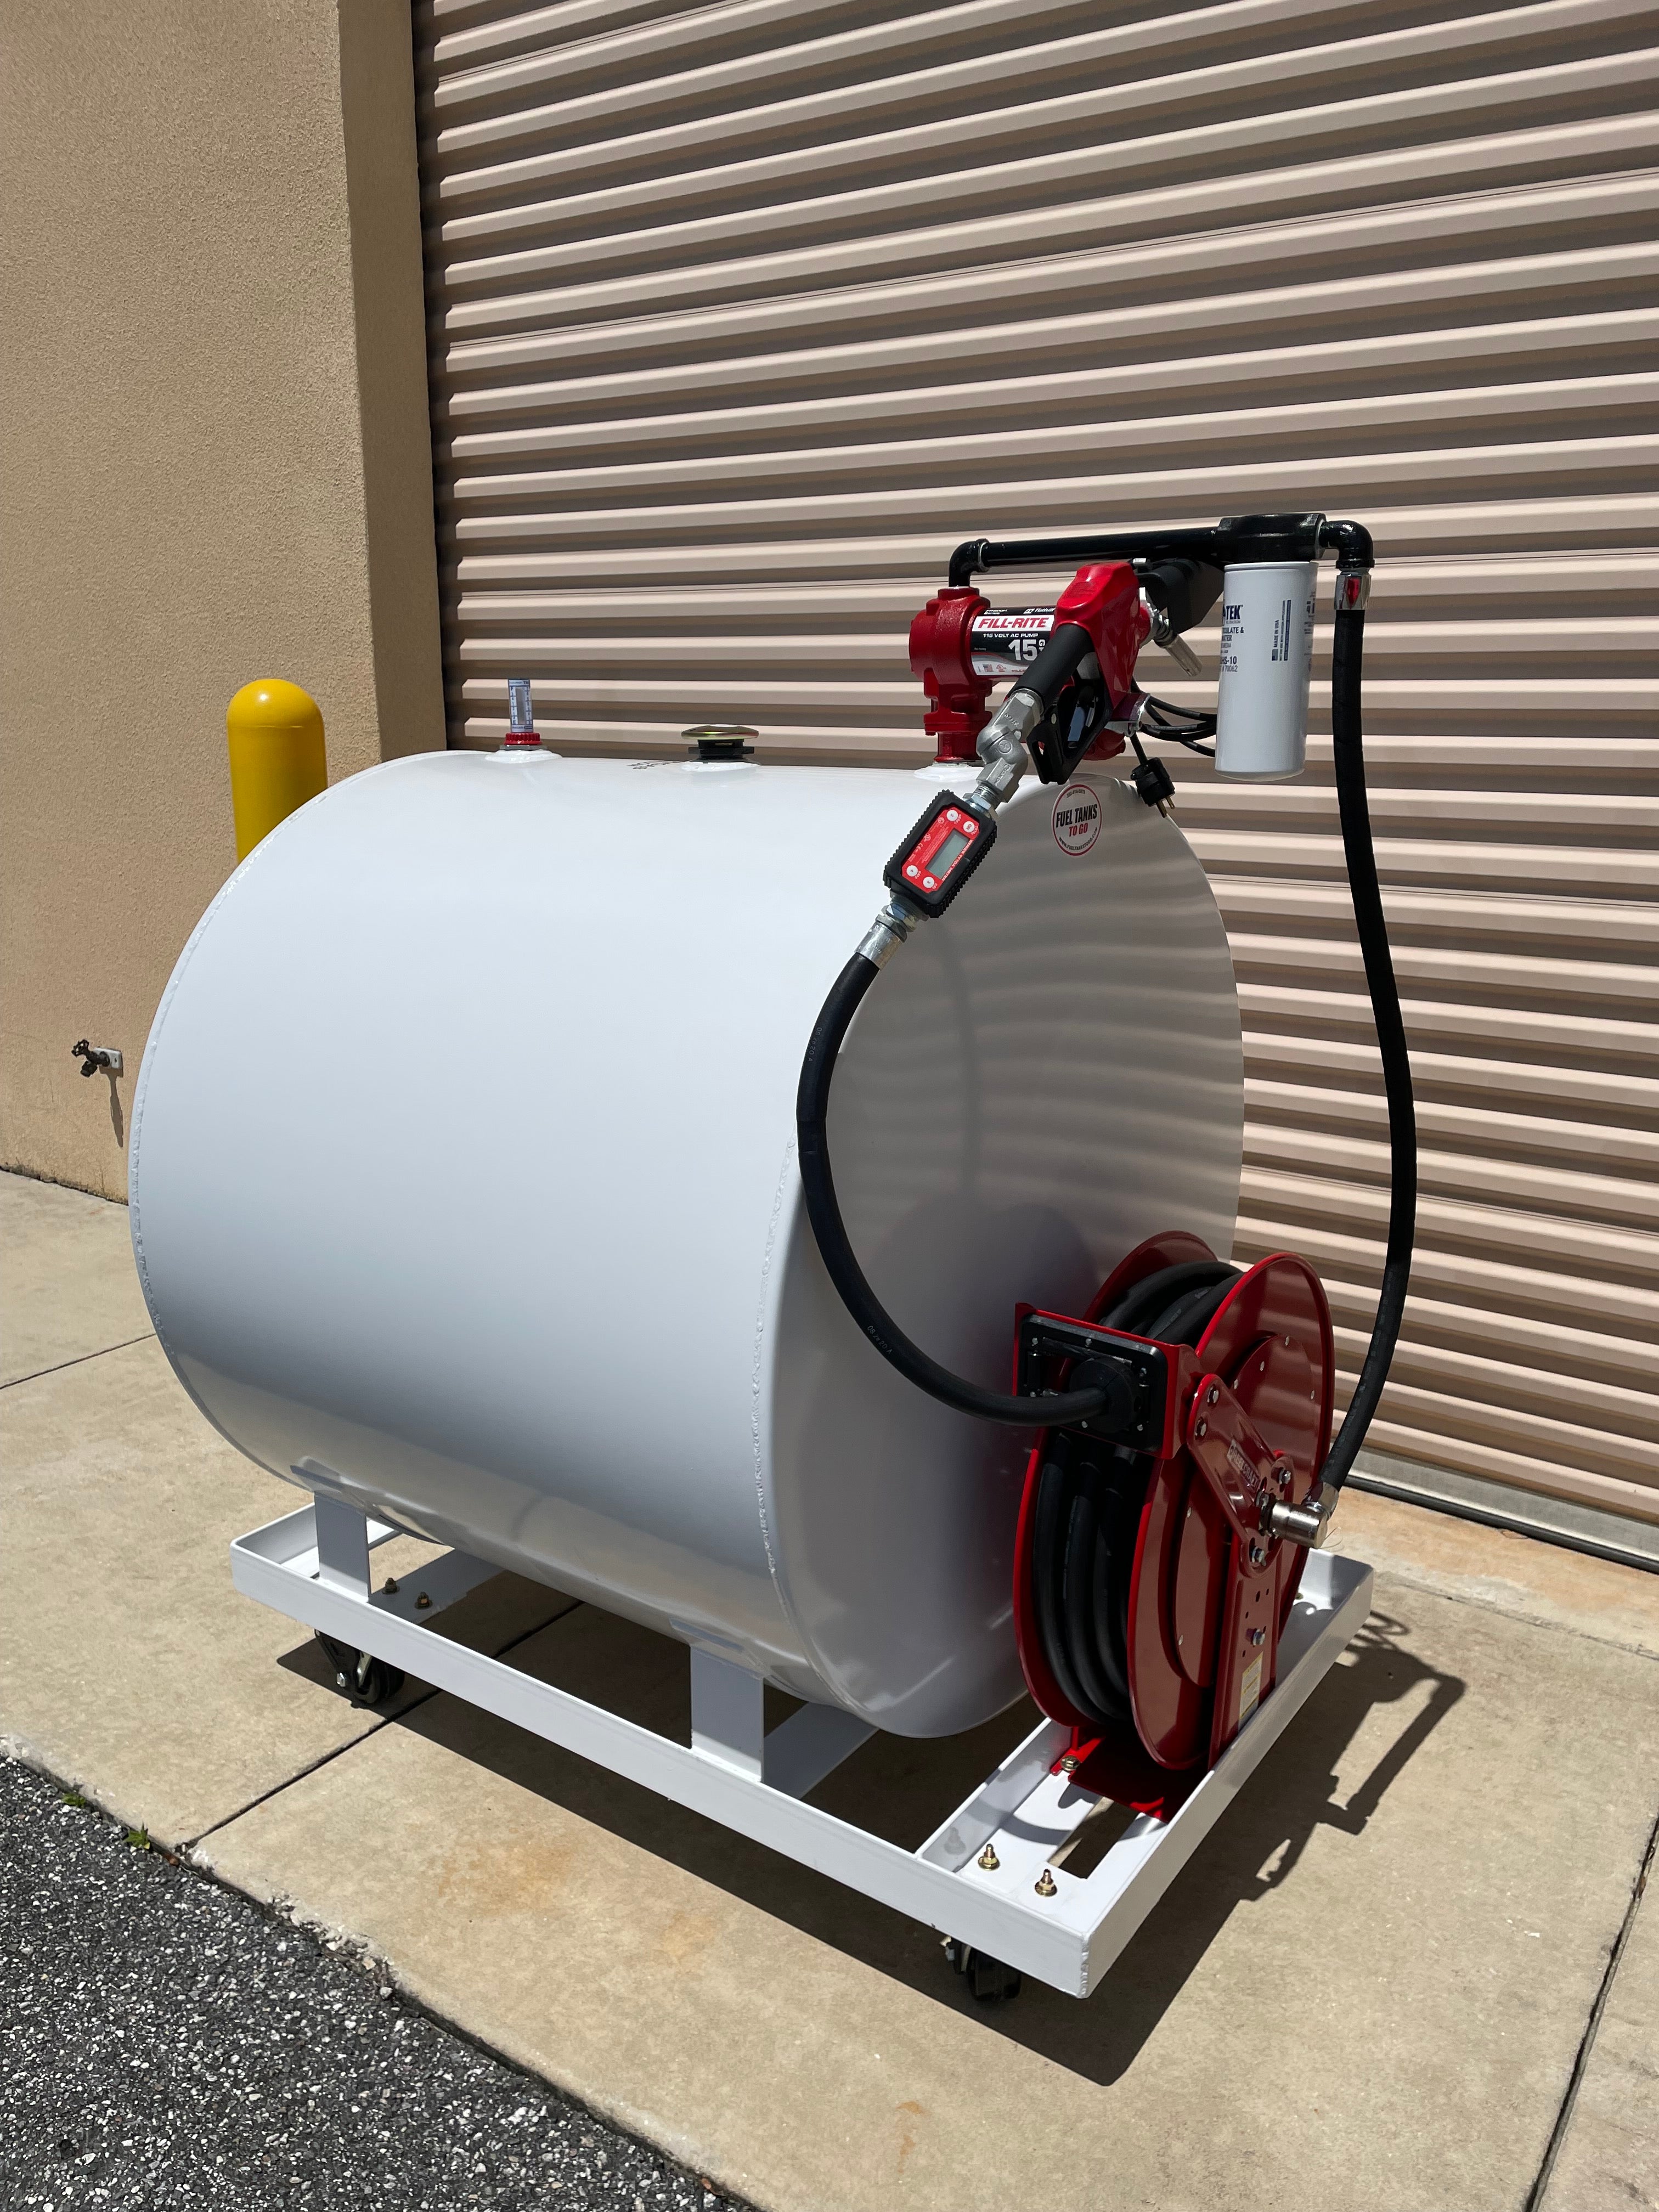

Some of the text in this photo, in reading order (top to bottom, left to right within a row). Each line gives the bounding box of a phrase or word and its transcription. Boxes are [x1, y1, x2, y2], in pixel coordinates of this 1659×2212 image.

[978, 618, 1049, 628] FILL-RITE
[1008, 639, 1037, 661] 15
[1056, 804, 1098, 828] FUEL TANKS
[1069, 823, 1088, 837] TO GO
